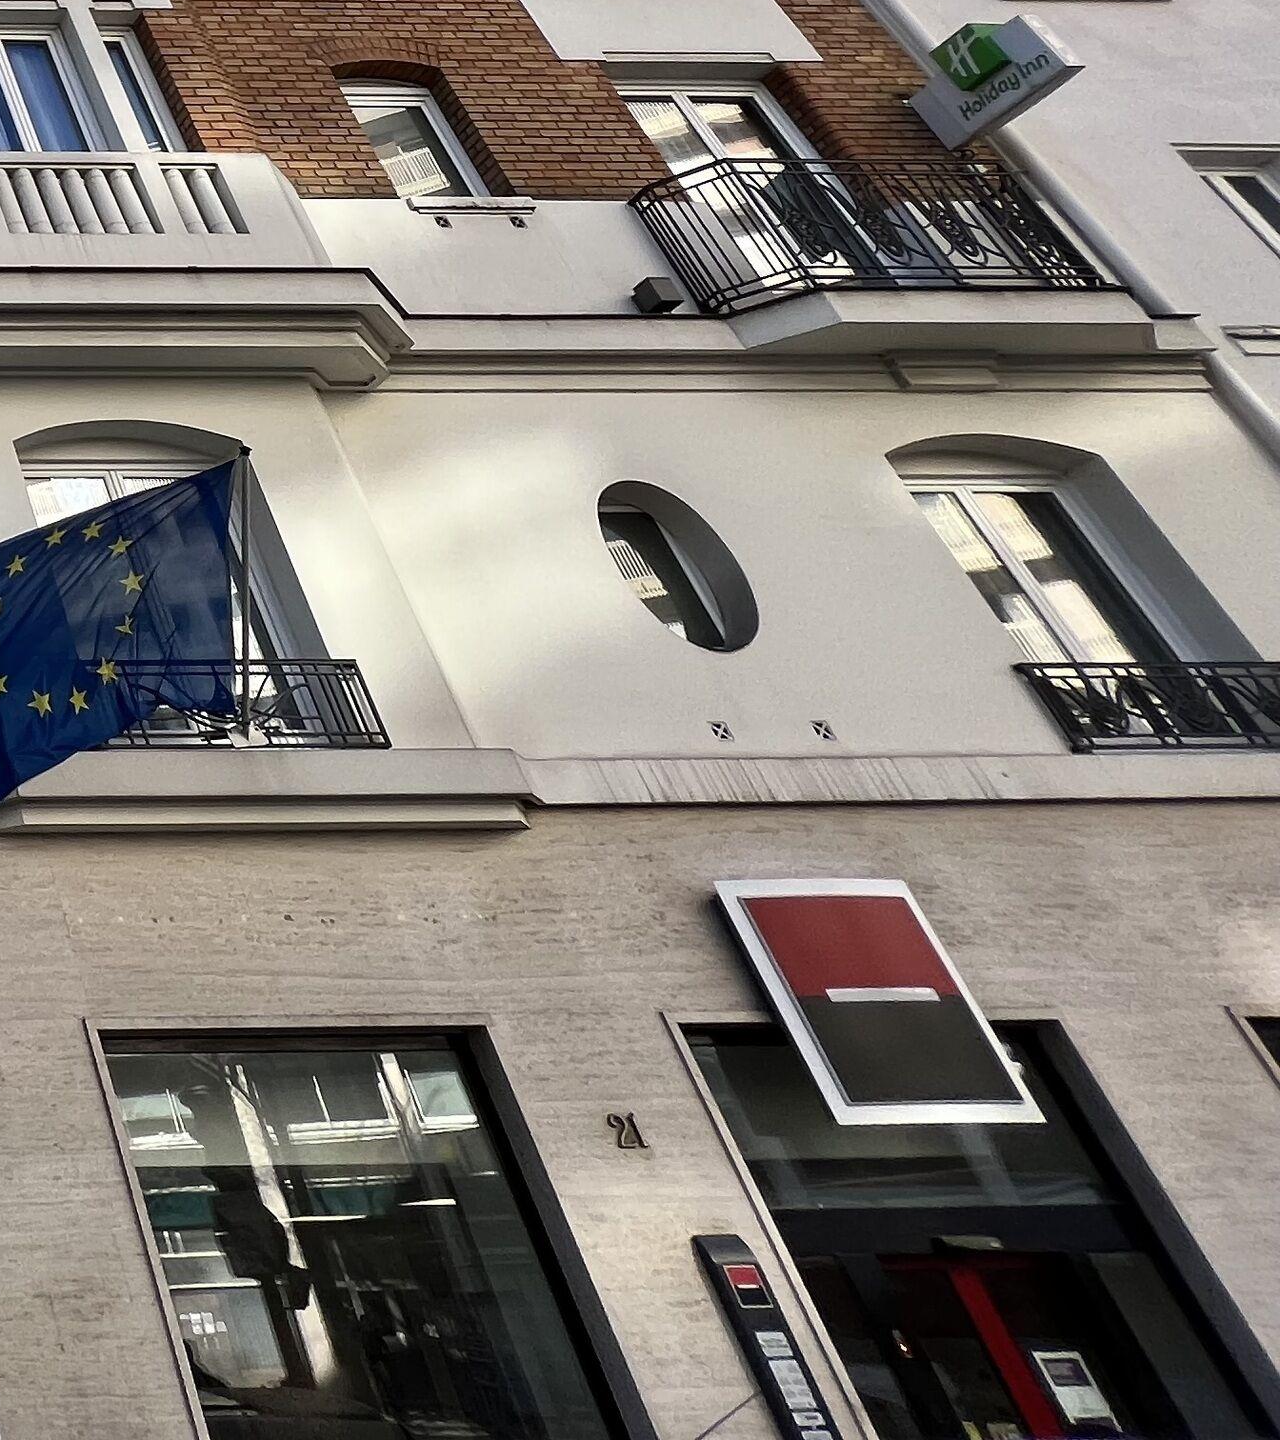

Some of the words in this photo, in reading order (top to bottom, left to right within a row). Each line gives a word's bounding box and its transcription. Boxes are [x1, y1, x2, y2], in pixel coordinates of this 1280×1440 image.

[958, 71, 1021, 122] Holiday
[1017, 52, 1050, 80] Inn
[606, 1112, 649, 1149] 21
